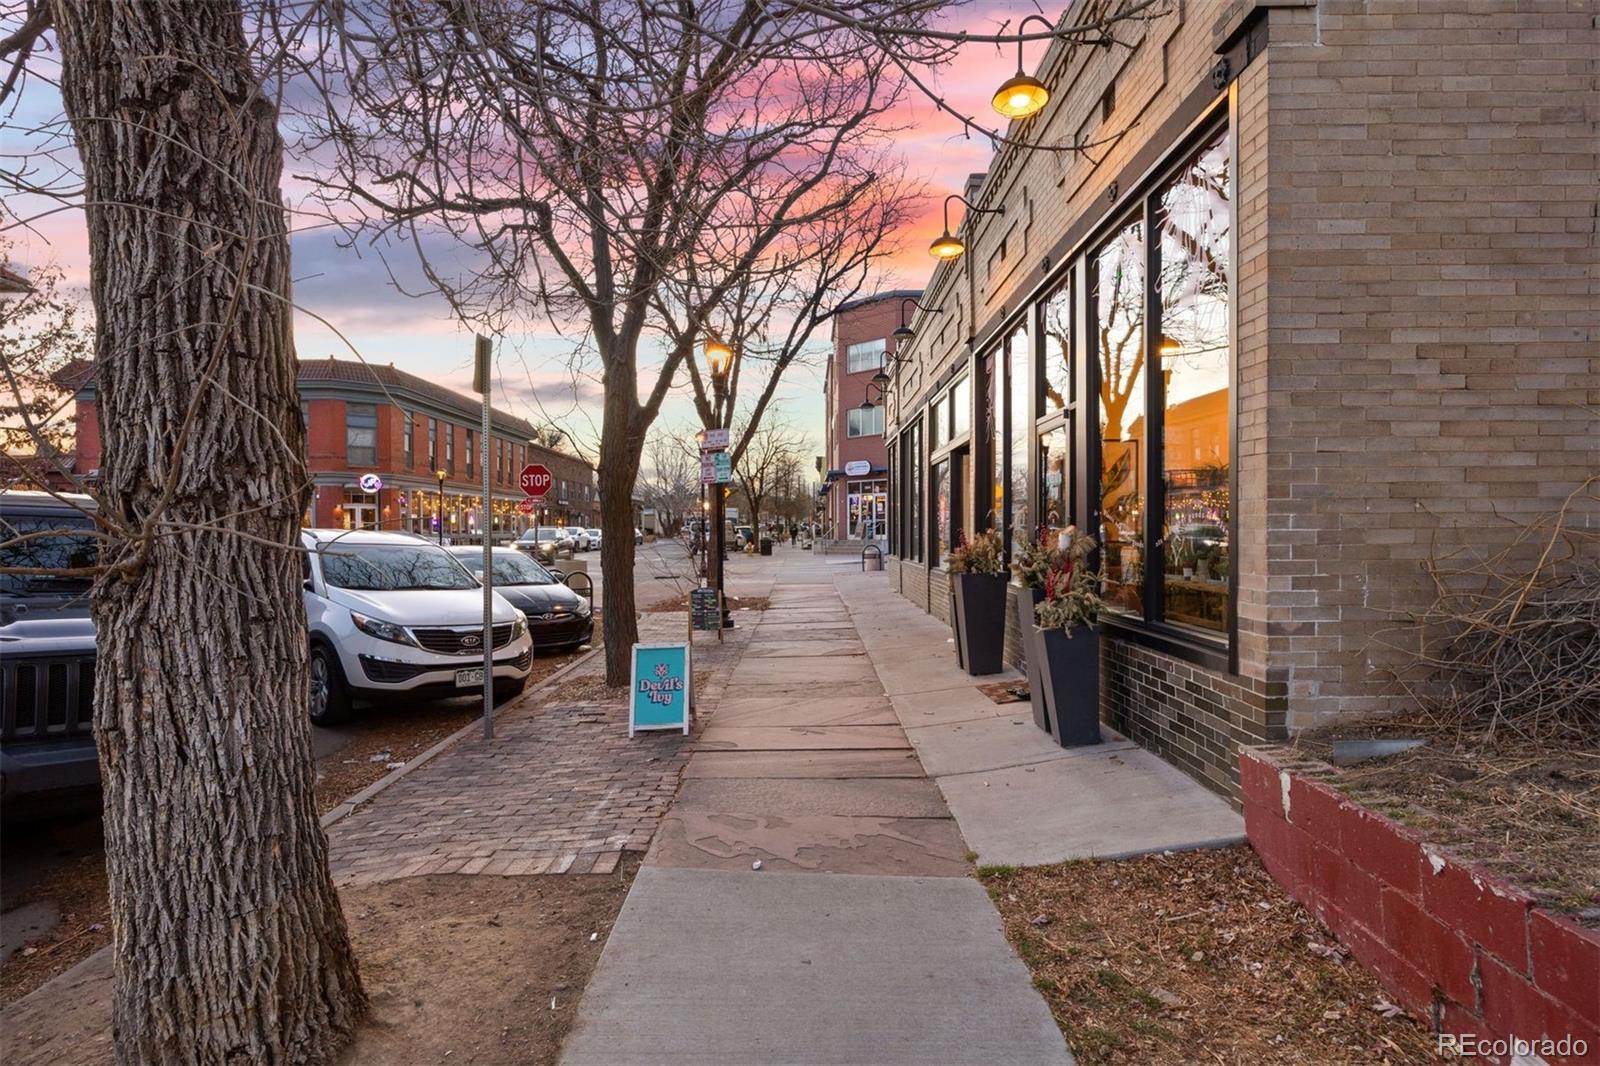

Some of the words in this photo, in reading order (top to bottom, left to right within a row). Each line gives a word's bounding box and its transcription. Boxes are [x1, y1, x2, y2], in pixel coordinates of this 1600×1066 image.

[521, 474, 550, 487] STOP
[639, 677, 684, 692] Devil's
[648, 691, 673, 705] Ivy
